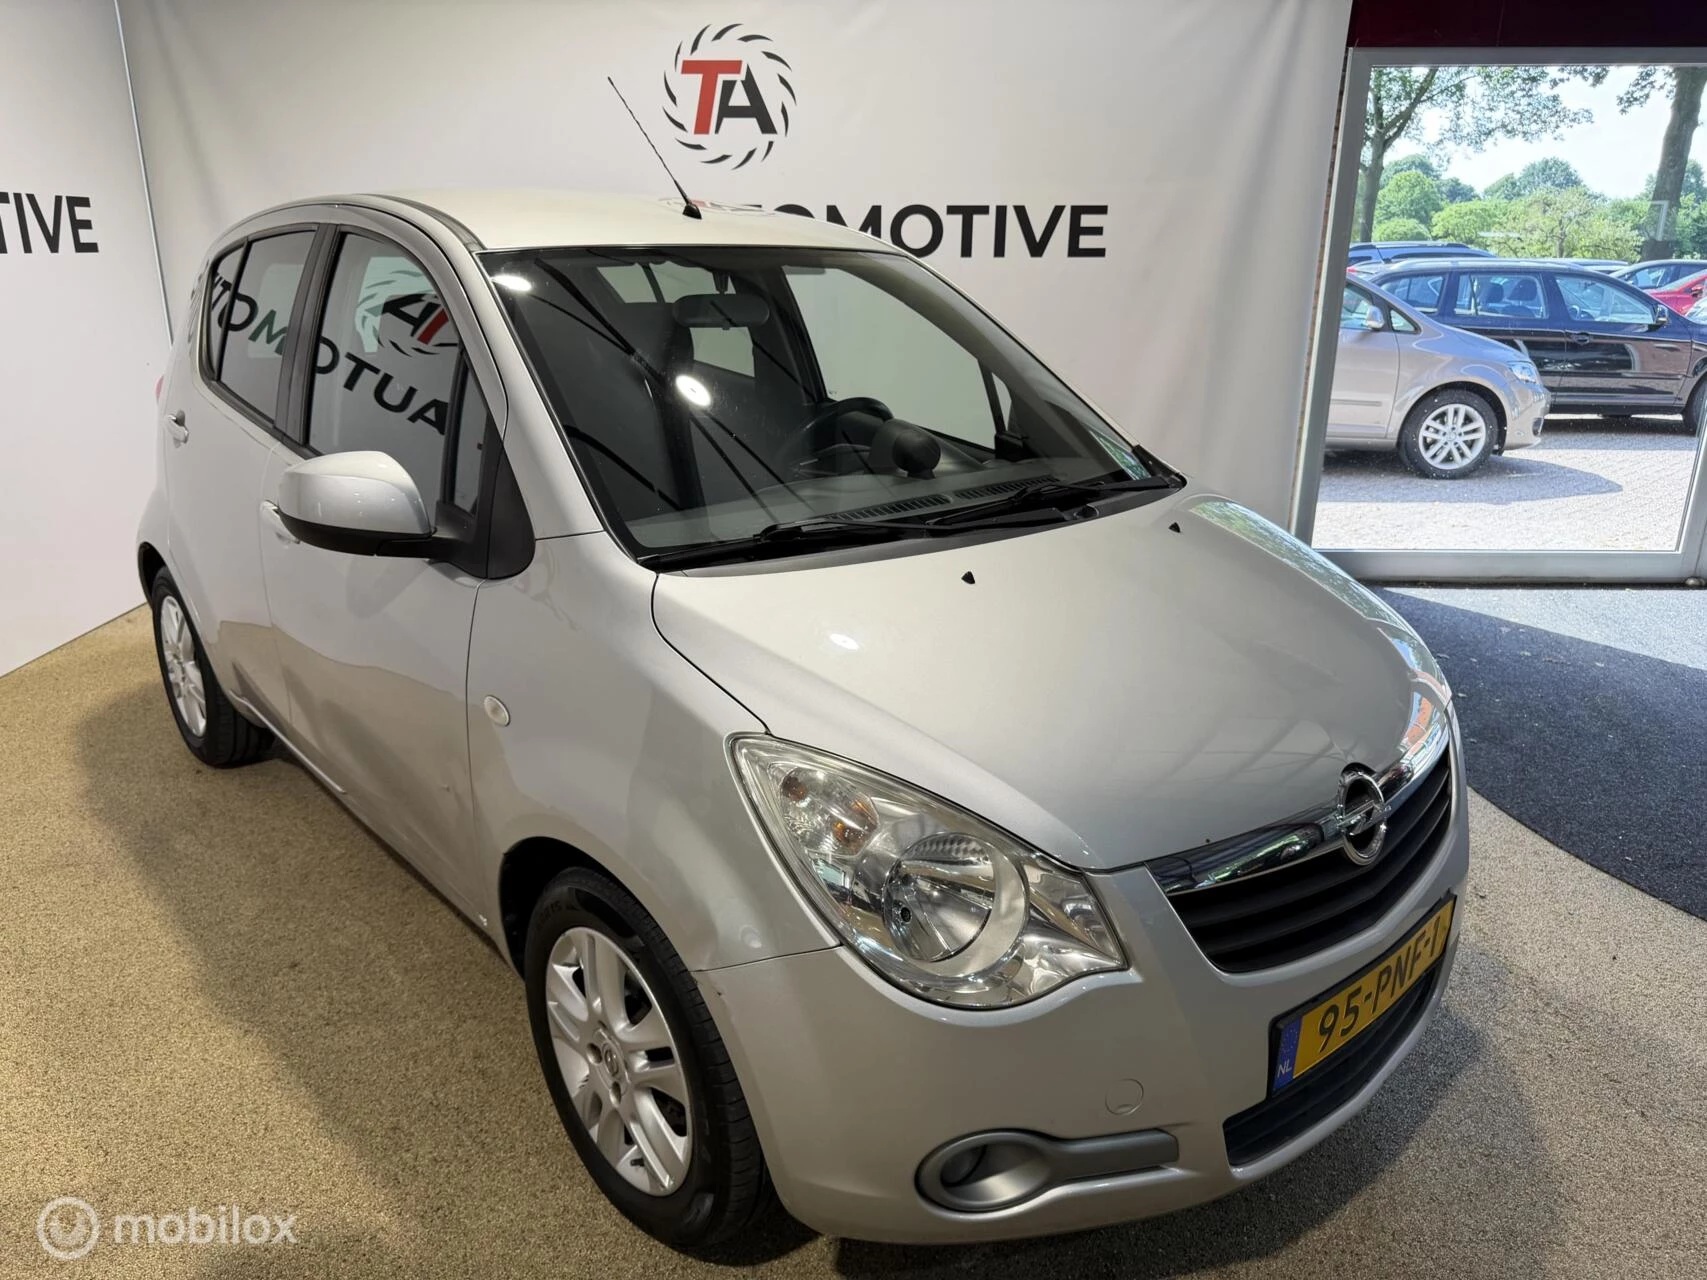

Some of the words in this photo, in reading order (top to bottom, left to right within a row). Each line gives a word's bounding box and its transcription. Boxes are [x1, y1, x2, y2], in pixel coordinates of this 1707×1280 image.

[681, 60, 778, 135] TA
[1277, 1059, 1293, 1078] NL
[1318, 916, 1441, 1053] 95-PNF-1
